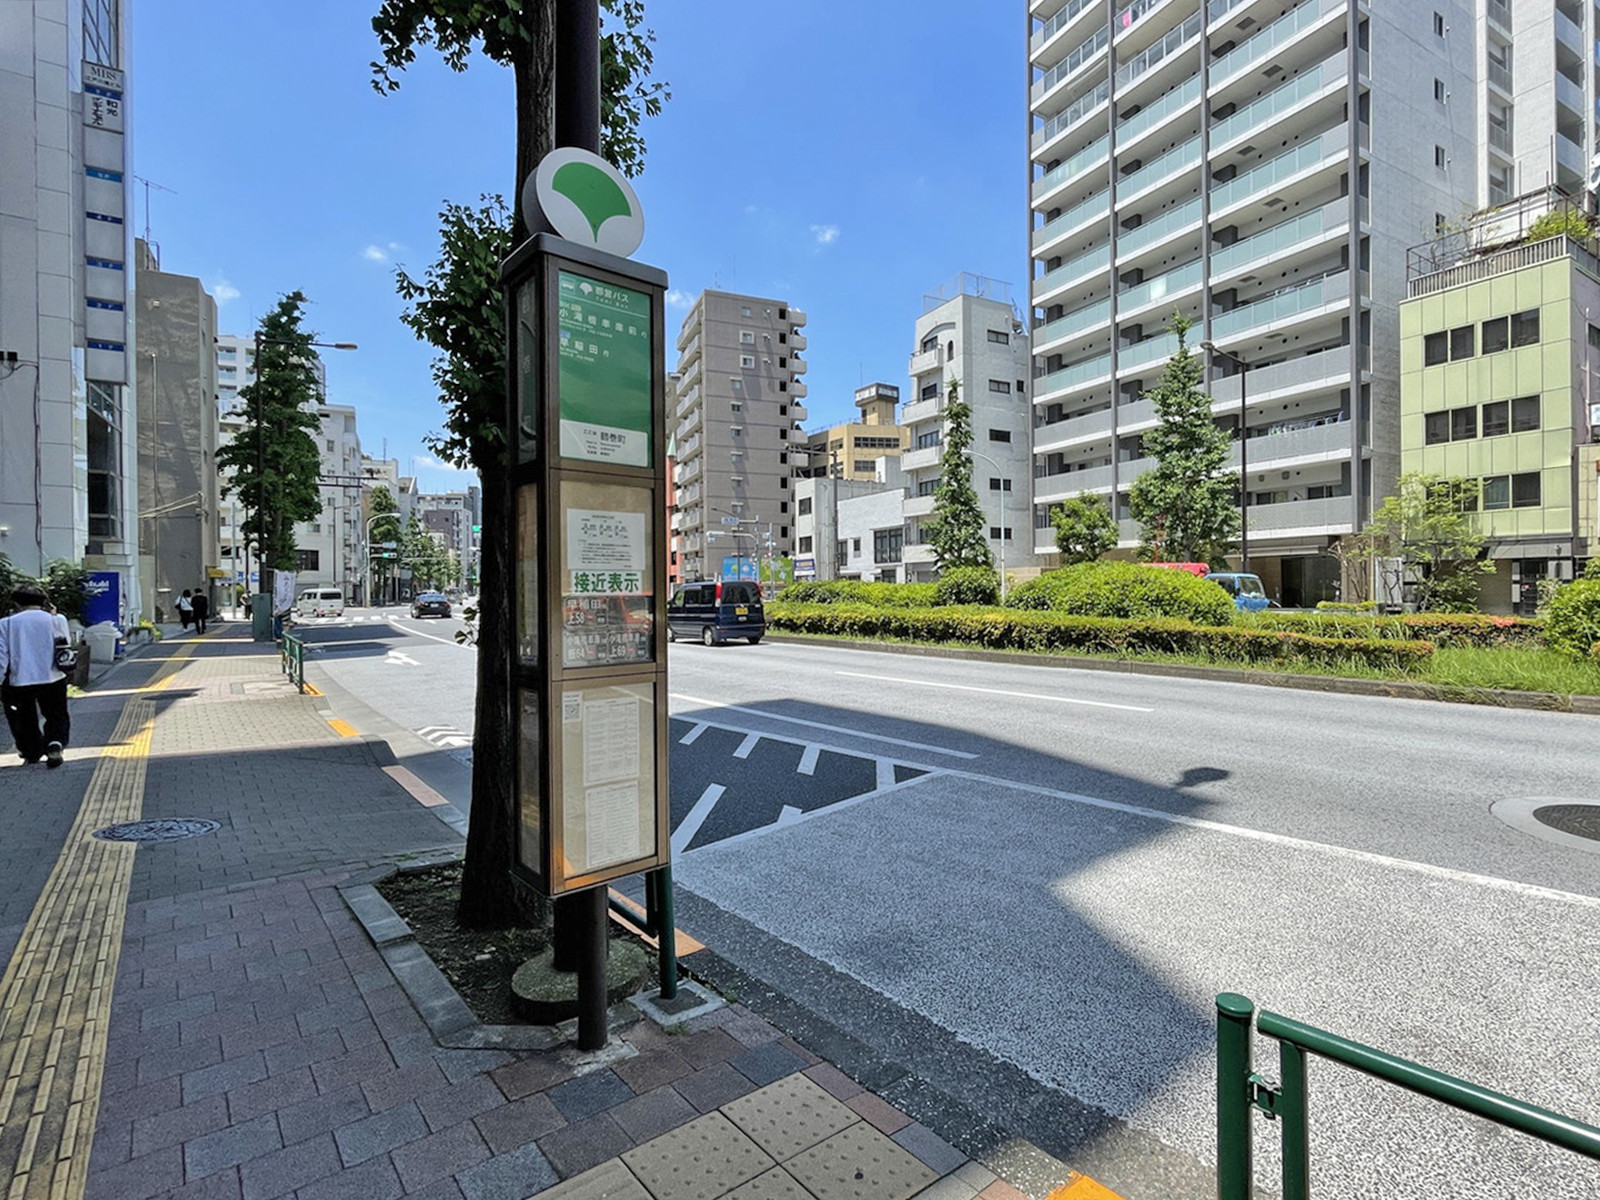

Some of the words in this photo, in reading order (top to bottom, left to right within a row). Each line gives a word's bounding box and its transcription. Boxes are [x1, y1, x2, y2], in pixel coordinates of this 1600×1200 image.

[595, 286, 629, 303] 都営バス
[574, 571, 639, 593] 接近表示
